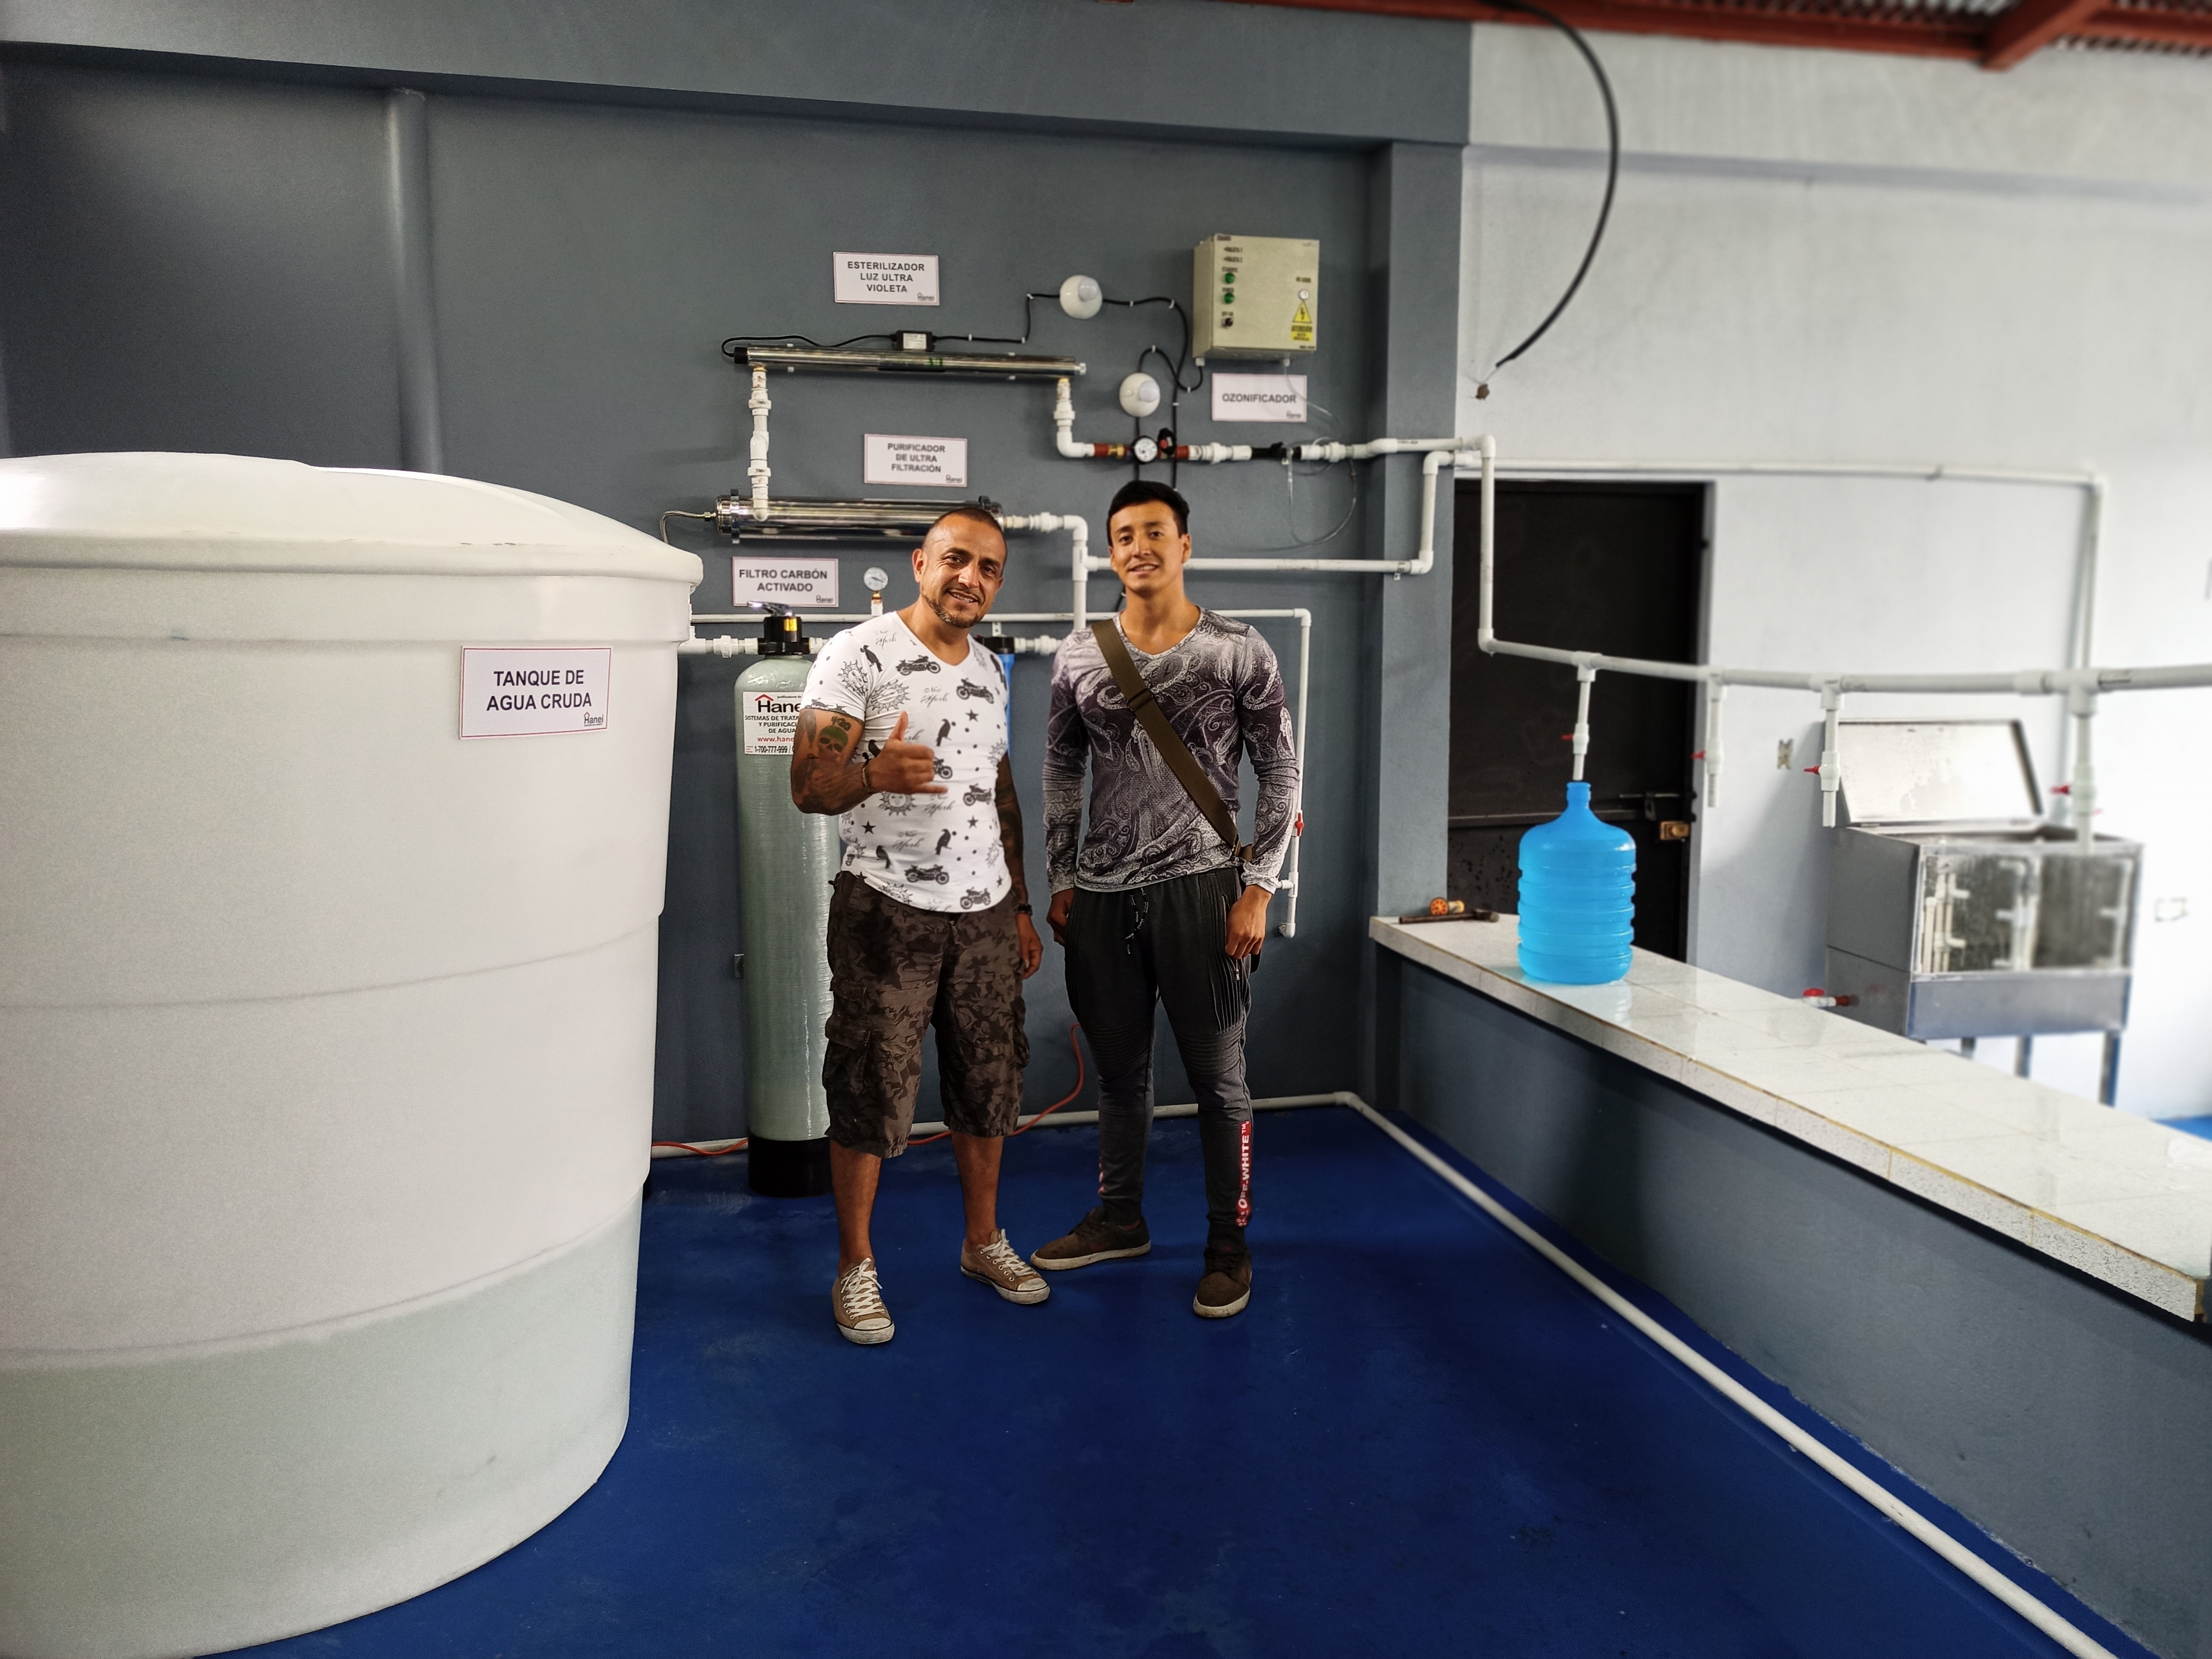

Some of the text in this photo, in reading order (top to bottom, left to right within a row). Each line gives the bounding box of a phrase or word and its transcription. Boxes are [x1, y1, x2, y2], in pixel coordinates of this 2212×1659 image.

[848, 261, 925, 271] ESTERILIZADOR
[866, 284, 907, 292] VIOLETA
[1222, 393, 1297, 403] OZONIFICADOR
[888, 443, 945, 452] PURIFICADOR
[891, 463, 941, 472] FILTRACIÓN
[739, 568, 827, 579] FILTRO CARBÓN
[757, 582, 813, 592] ACTIVADO
[493, 670, 584, 686] TANQUE DE
[486, 693, 592, 711] AGUA CRUDA
[758, 700, 801, 713] Hane
[584, 713, 604, 724] Hanei
